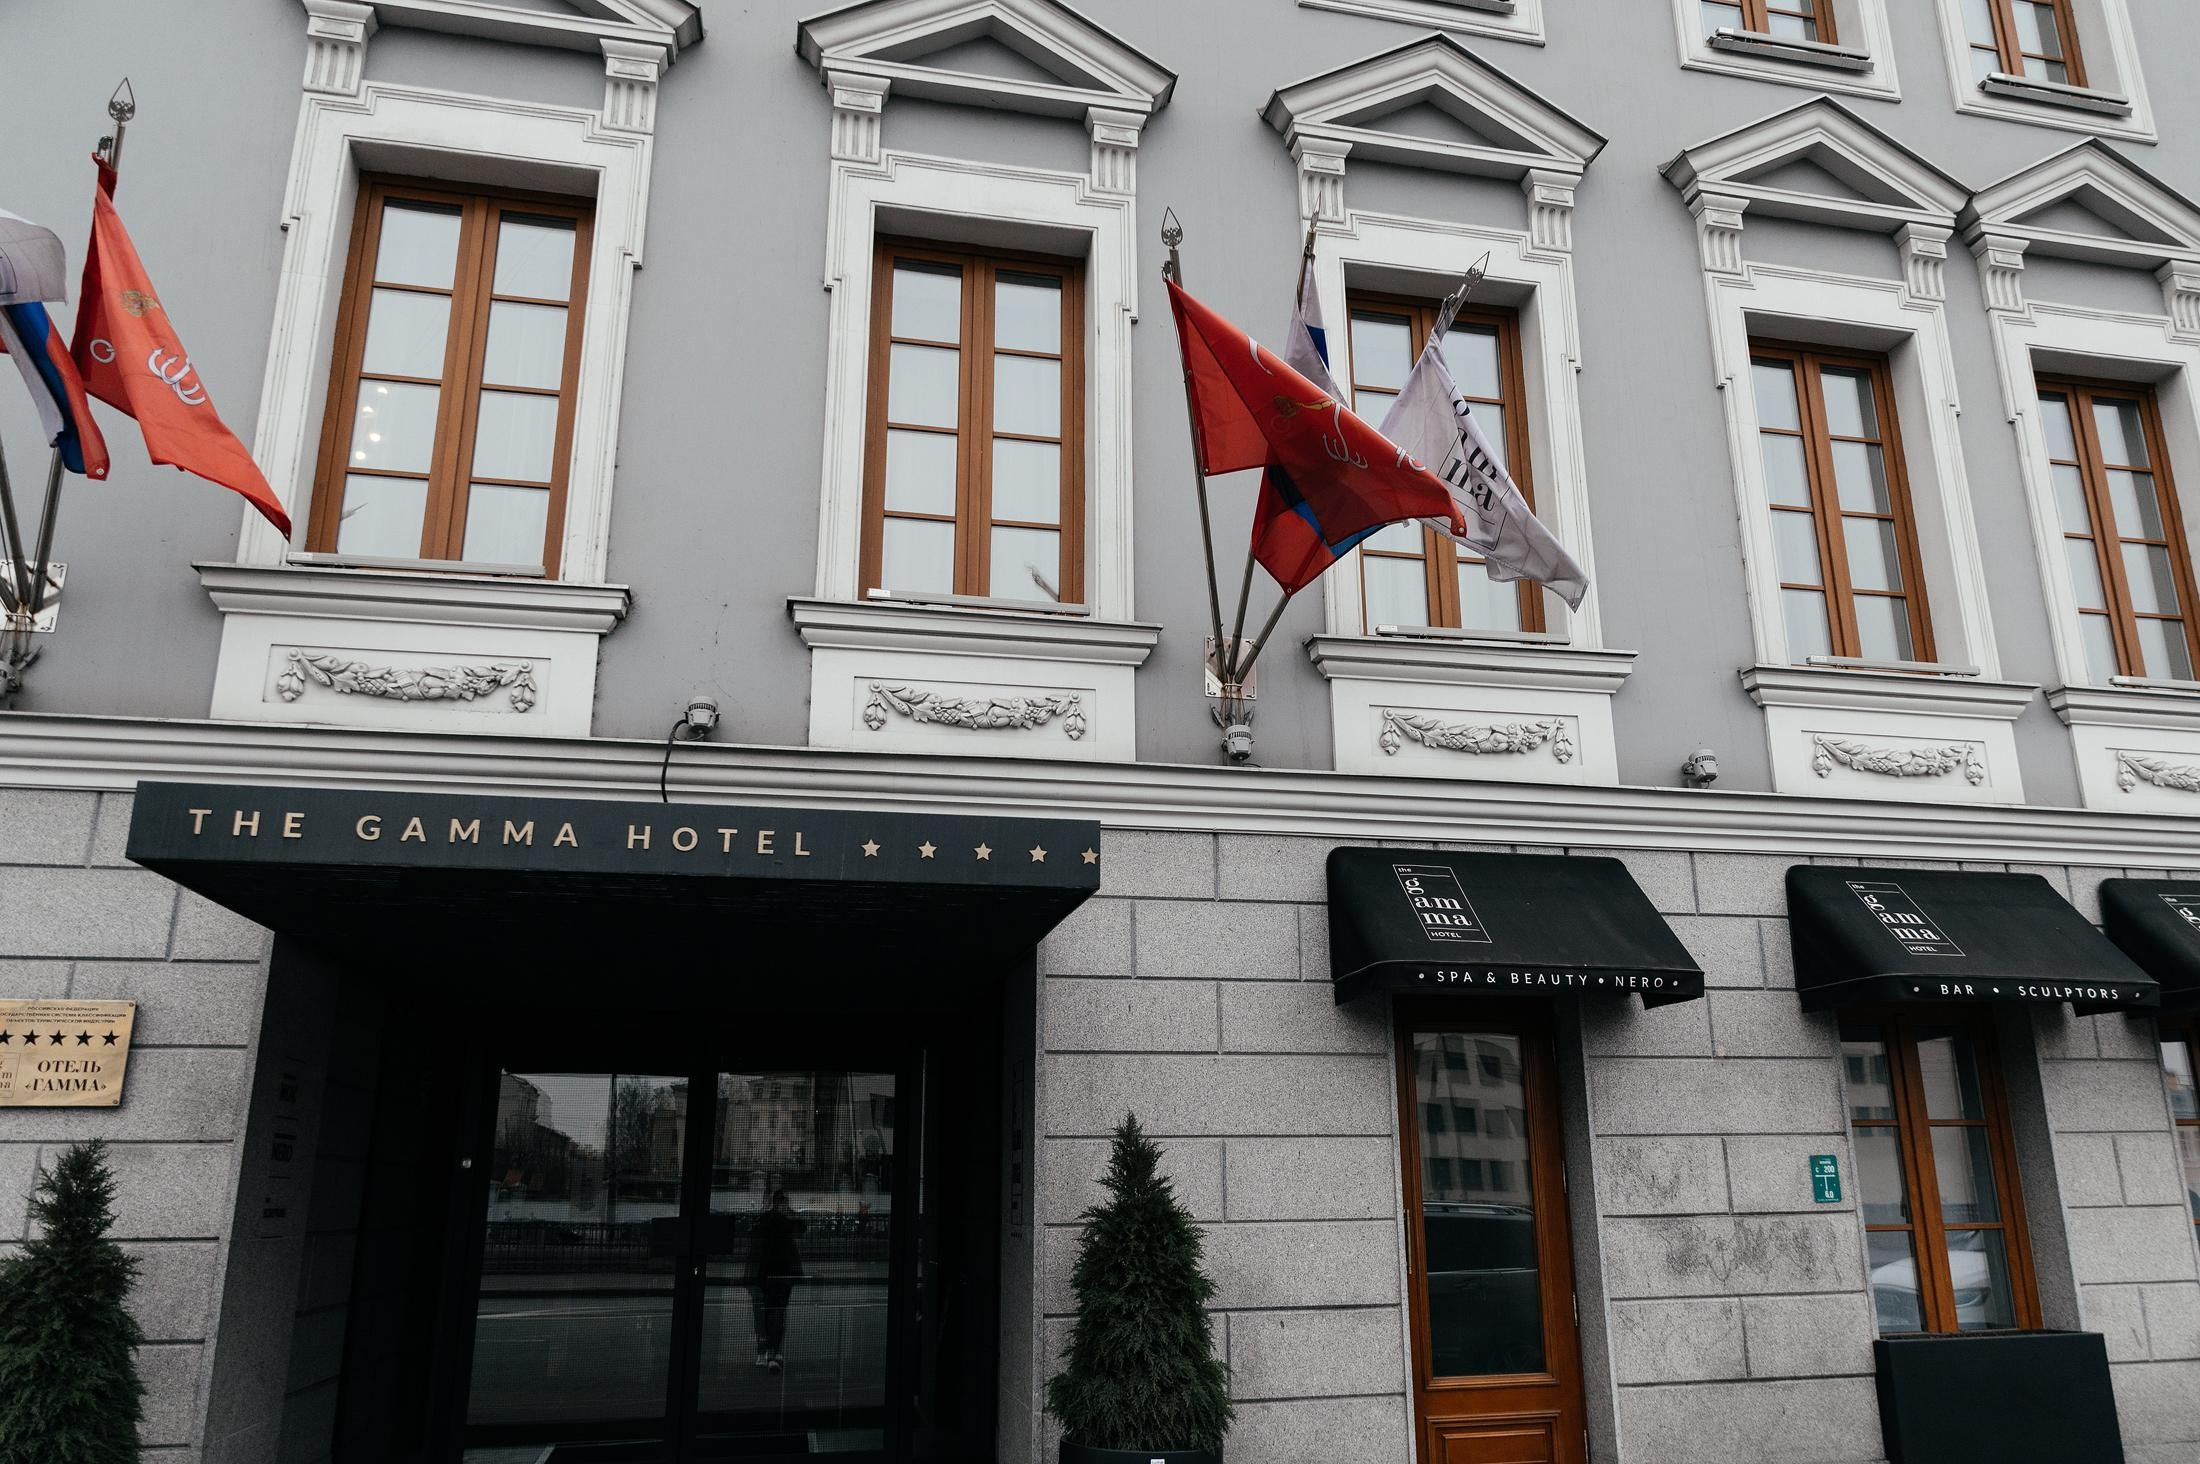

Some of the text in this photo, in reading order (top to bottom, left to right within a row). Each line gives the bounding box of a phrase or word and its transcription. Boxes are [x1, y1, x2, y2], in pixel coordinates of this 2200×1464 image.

[189, 808, 811, 857] THE GAMMA HOTEL
[1405, 877, 1425, 895] g
[1414, 896, 1464, 910] am
[1420, 912, 1473, 926] ma
[1437, 971, 1664, 988] SPA & BEAUTY NERO
[1940, 984, 2119, 999] BAR SCULPTORS
[37, 1060, 102, 1073] ОТЕЛЬ
[25, 1078, 107, 1091] «ГАММА»
[1823, 1165, 1835, 1173] 200
